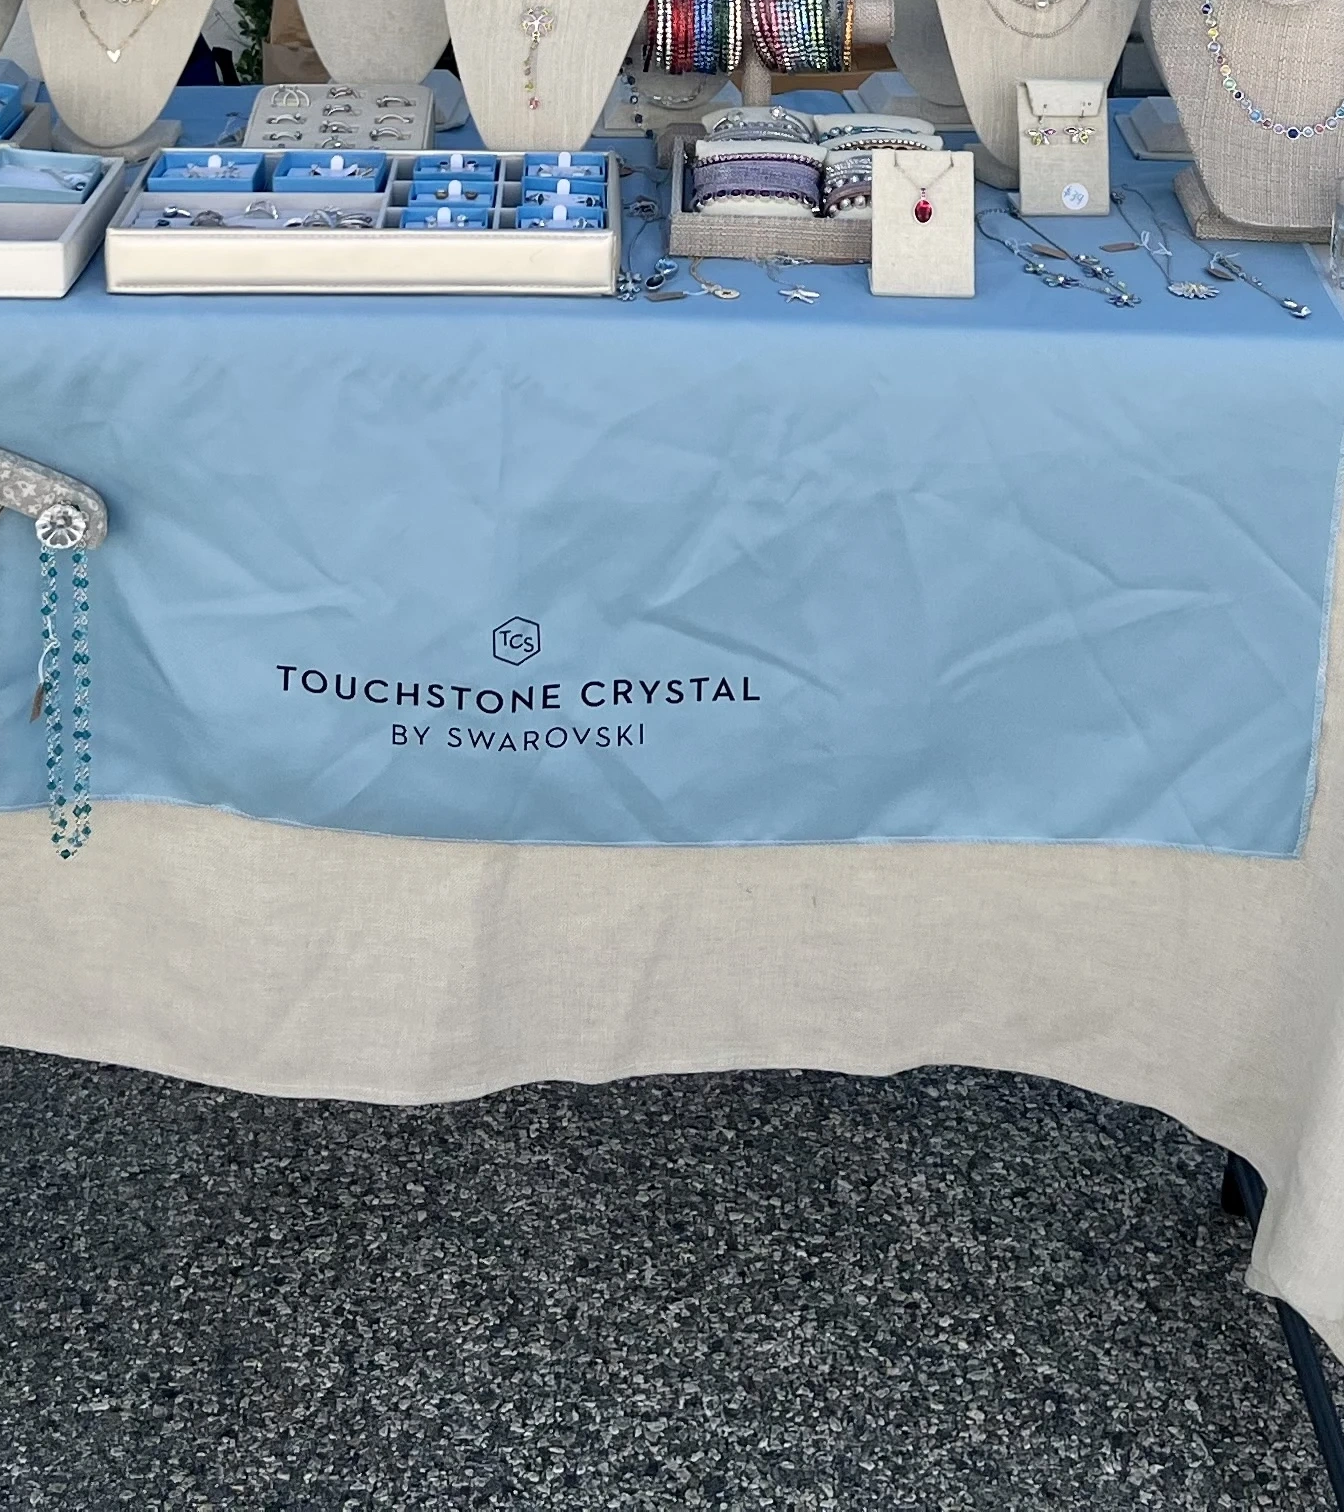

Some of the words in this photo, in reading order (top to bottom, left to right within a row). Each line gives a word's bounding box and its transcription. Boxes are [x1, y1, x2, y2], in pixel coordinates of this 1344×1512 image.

[499, 630, 534, 653] TCS
[276, 665, 562, 715] TOUCHSTONE
[580, 675, 761, 708] CRYSTAL
[392, 723, 430, 746] BY
[447, 723, 645, 753] SWAROVSKI
